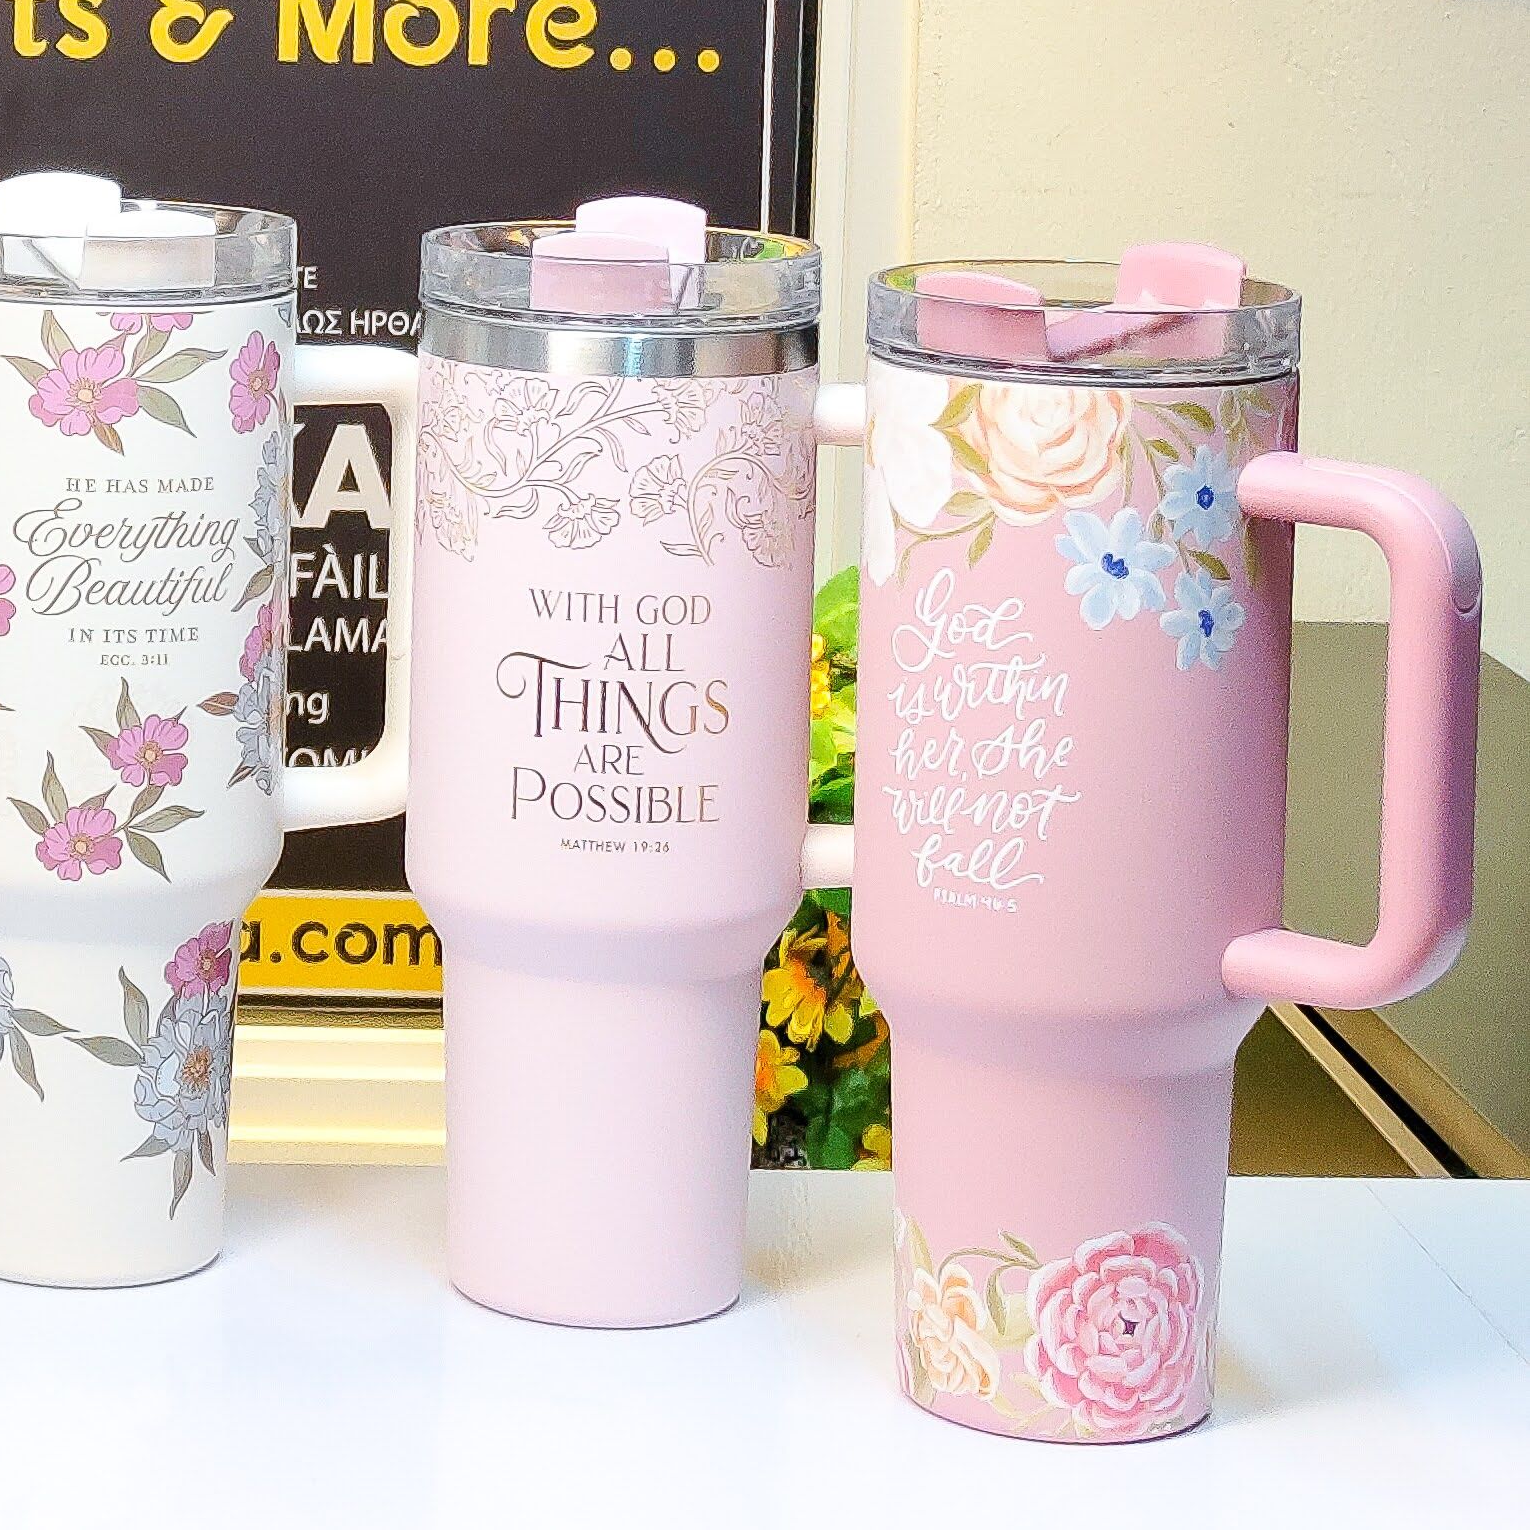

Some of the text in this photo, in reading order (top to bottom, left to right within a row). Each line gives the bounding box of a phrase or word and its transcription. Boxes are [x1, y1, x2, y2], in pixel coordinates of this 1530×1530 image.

[66, 476, 214, 494] HE HAS MADE
[13, 497, 240, 563] Everything
[25, 554, 234, 617] Beautiful
[528, 587, 712, 625] WITH GOD
[70, 627, 200, 644] IN ITS TIME
[891, 567, 1034, 673] God
[100, 654, 136, 667] ECC.
[603, 632, 687, 672] ALL
[496, 651, 731, 755] THINGS
[573, 743, 646, 776] ARE
[511, 766, 721, 824] POSSIBLE
[967, 783, 1084, 842] not
[560, 838, 670, 854] MATTHEW 19:26
[910, 832, 1045, 890] fall
